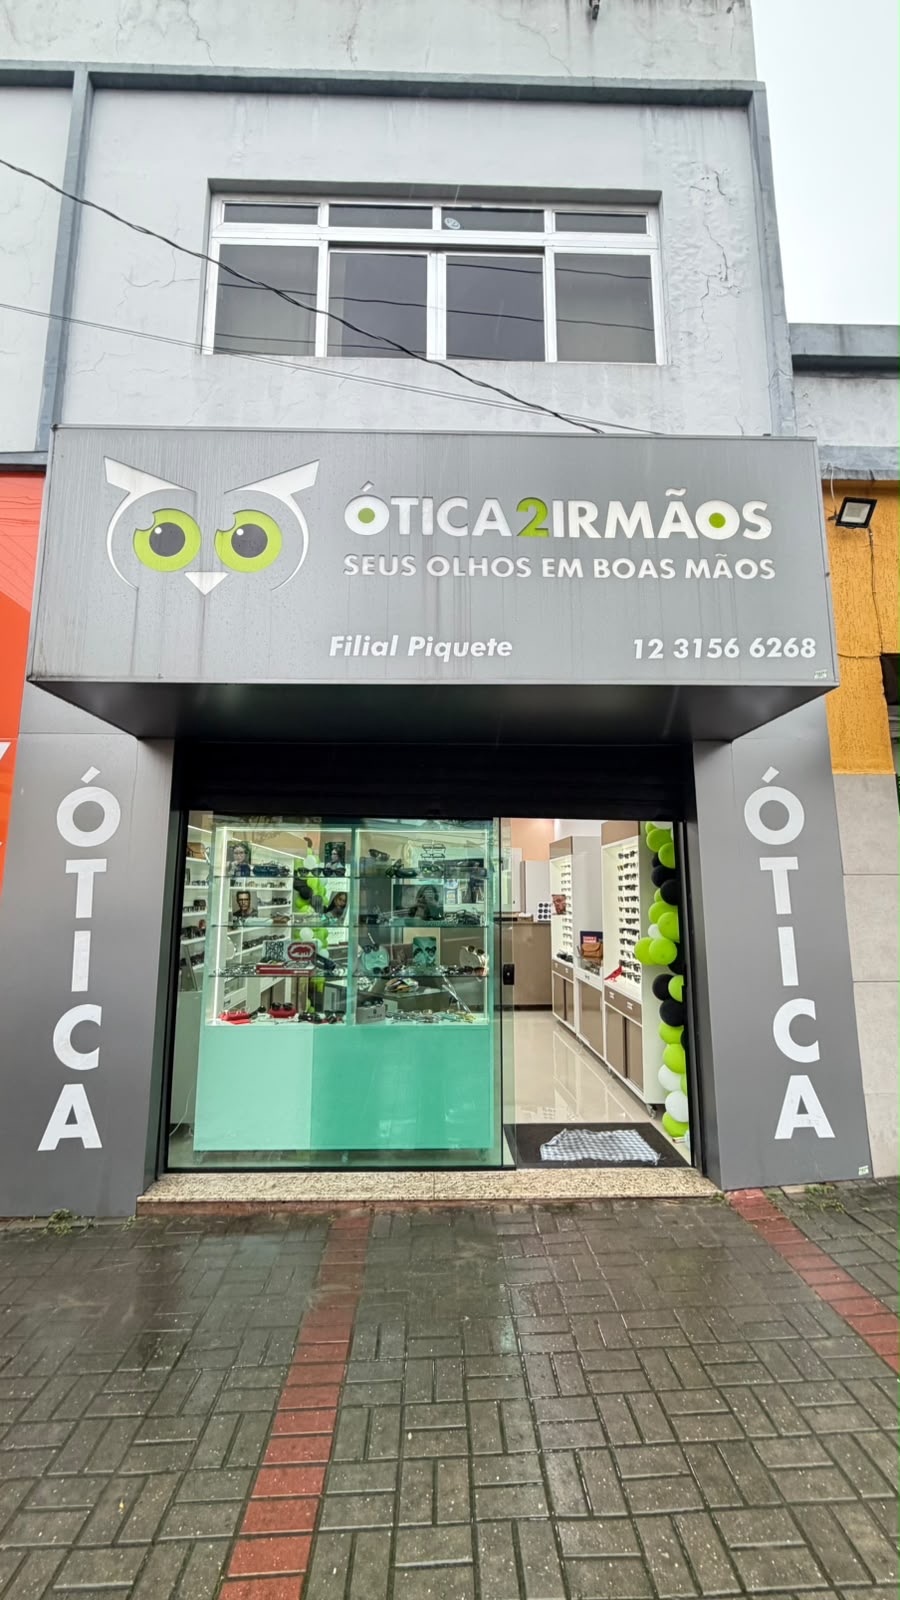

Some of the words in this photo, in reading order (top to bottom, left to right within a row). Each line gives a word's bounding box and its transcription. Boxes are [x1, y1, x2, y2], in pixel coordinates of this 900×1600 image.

[343, 553, 417, 577] SEUS
[426, 555, 532, 578] OLHOS
[541, 557, 584, 579] EM
[593, 557, 676, 580] BOAS
[685, 553, 776, 580] MÃOS
[329, 634, 399, 657] Filial
[407, 635, 513, 663] Piquete
[633, 638, 664, 660] 12
[673, 637, 740, 660] 3156
[749, 636, 817, 660] 6268
[37, 766, 121, 1151] ÓTICA
[744, 766, 836, 1140] ÓTICA
